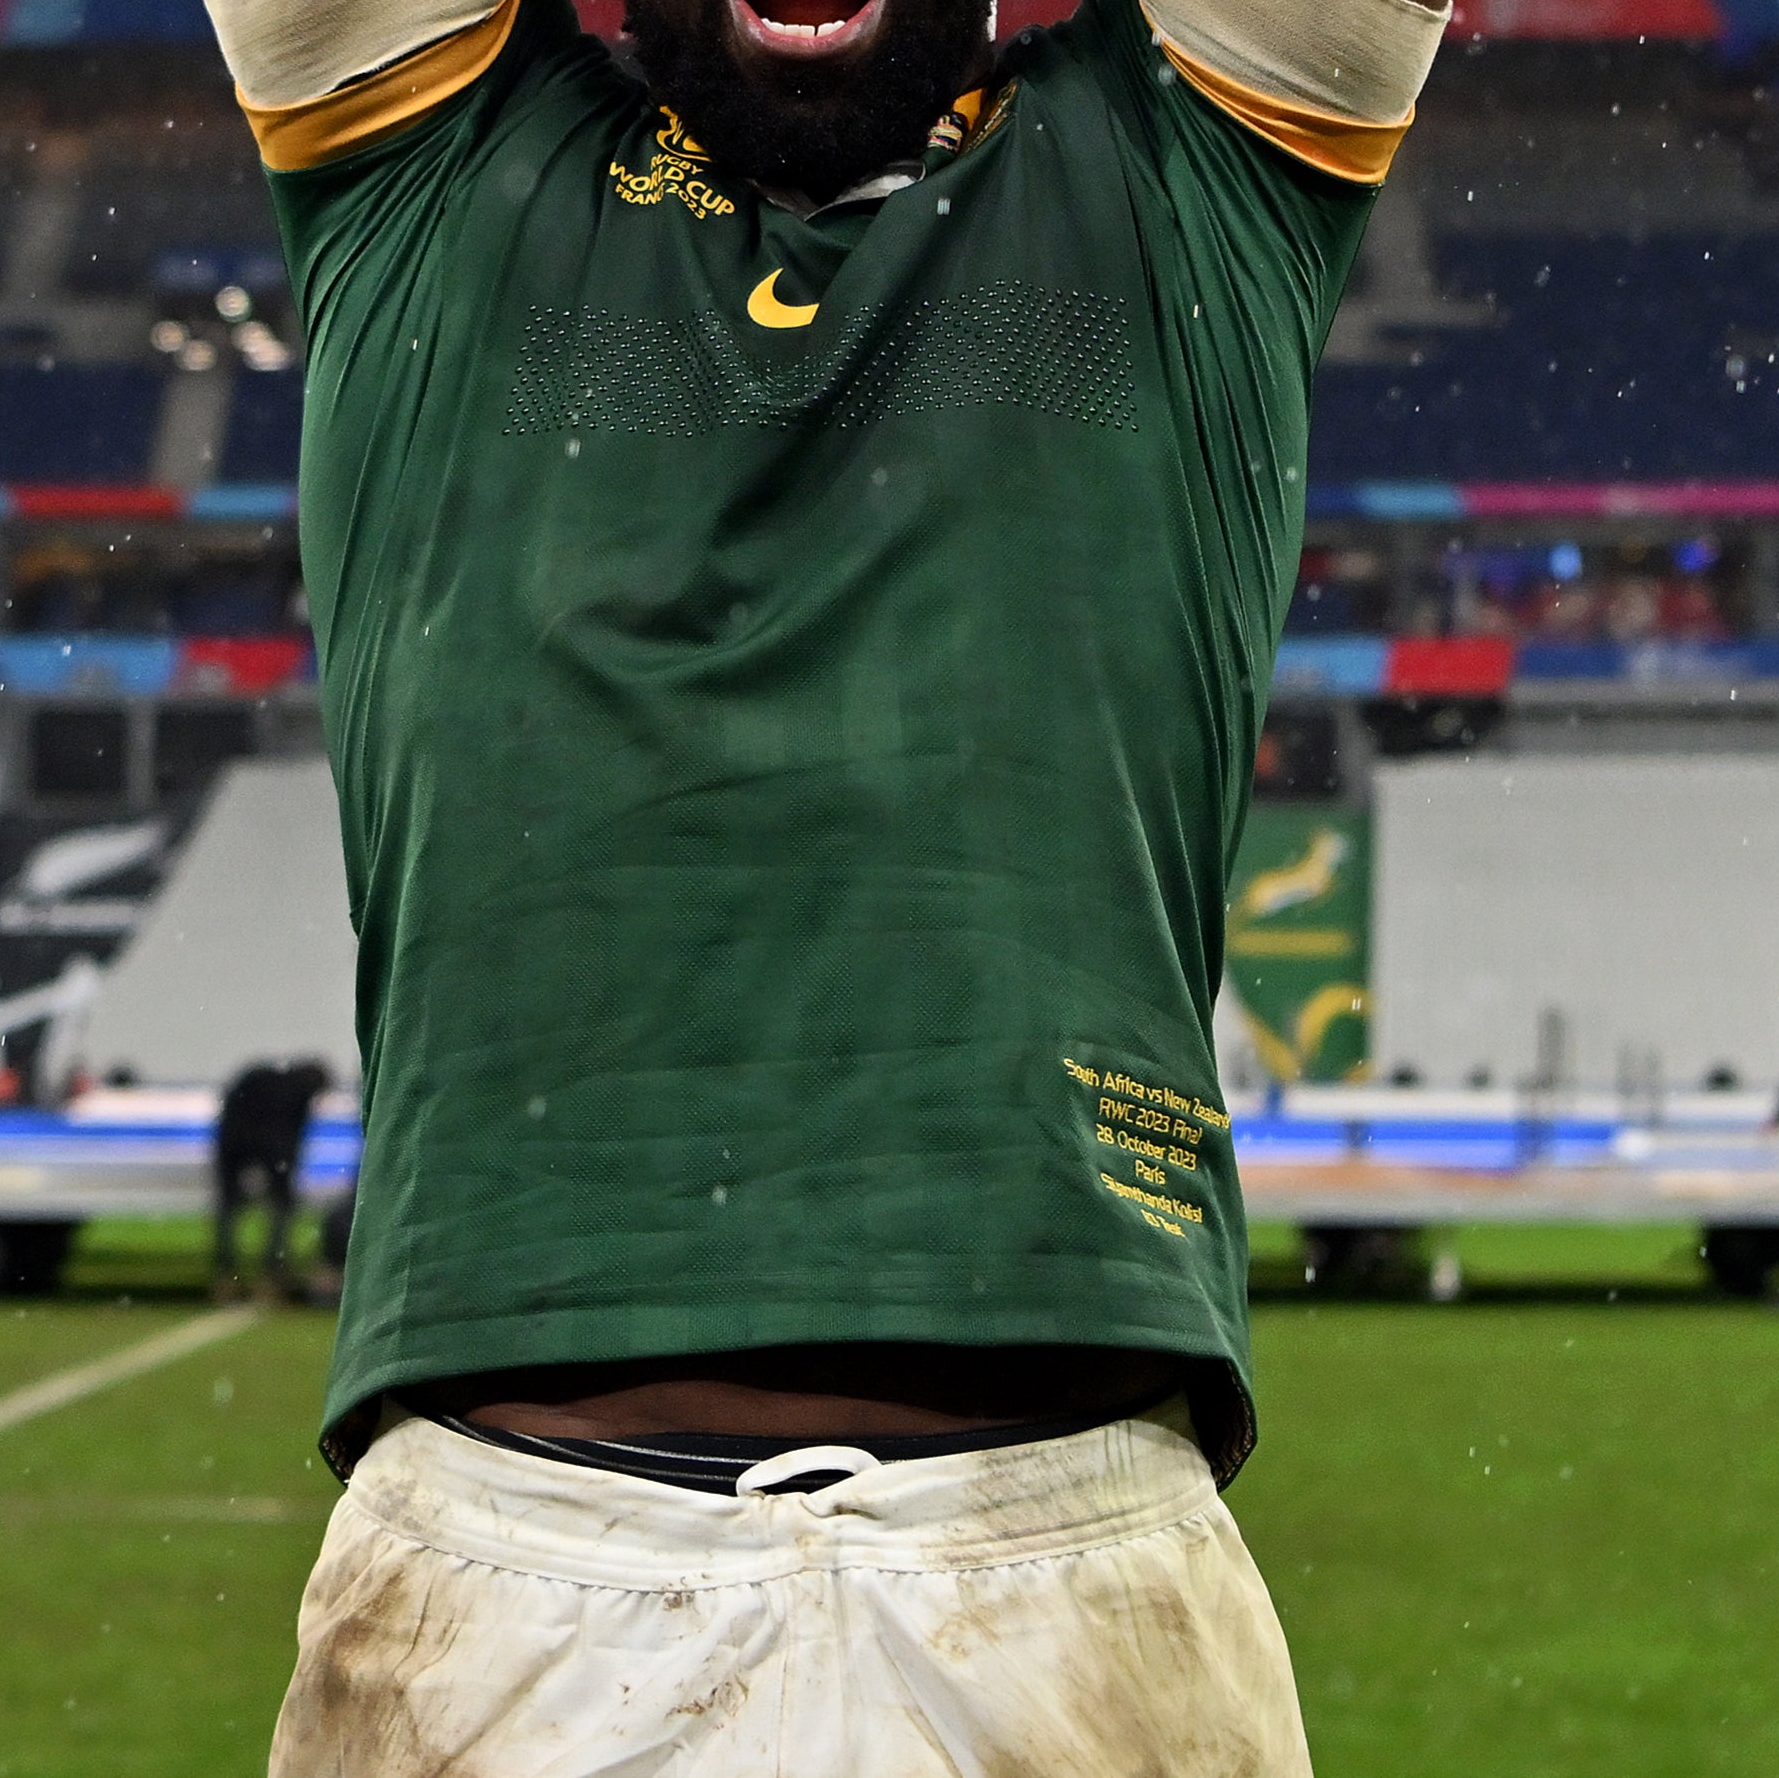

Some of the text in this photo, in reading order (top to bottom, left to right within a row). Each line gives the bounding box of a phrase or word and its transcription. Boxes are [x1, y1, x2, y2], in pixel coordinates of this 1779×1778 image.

[650, 153, 704, 175] RUGBY
[609, 161, 735, 216] WORLD CUP
[665, 182, 707, 220] 2023
[1063, 1058, 1230, 1129] South Africa vs New Zealand
[1099, 1096, 1204, 1145] RWC 2023 Final
[1096, 1123, 1197, 1171] 28 October 2023
[1135, 1159, 1166, 1184] Paris
